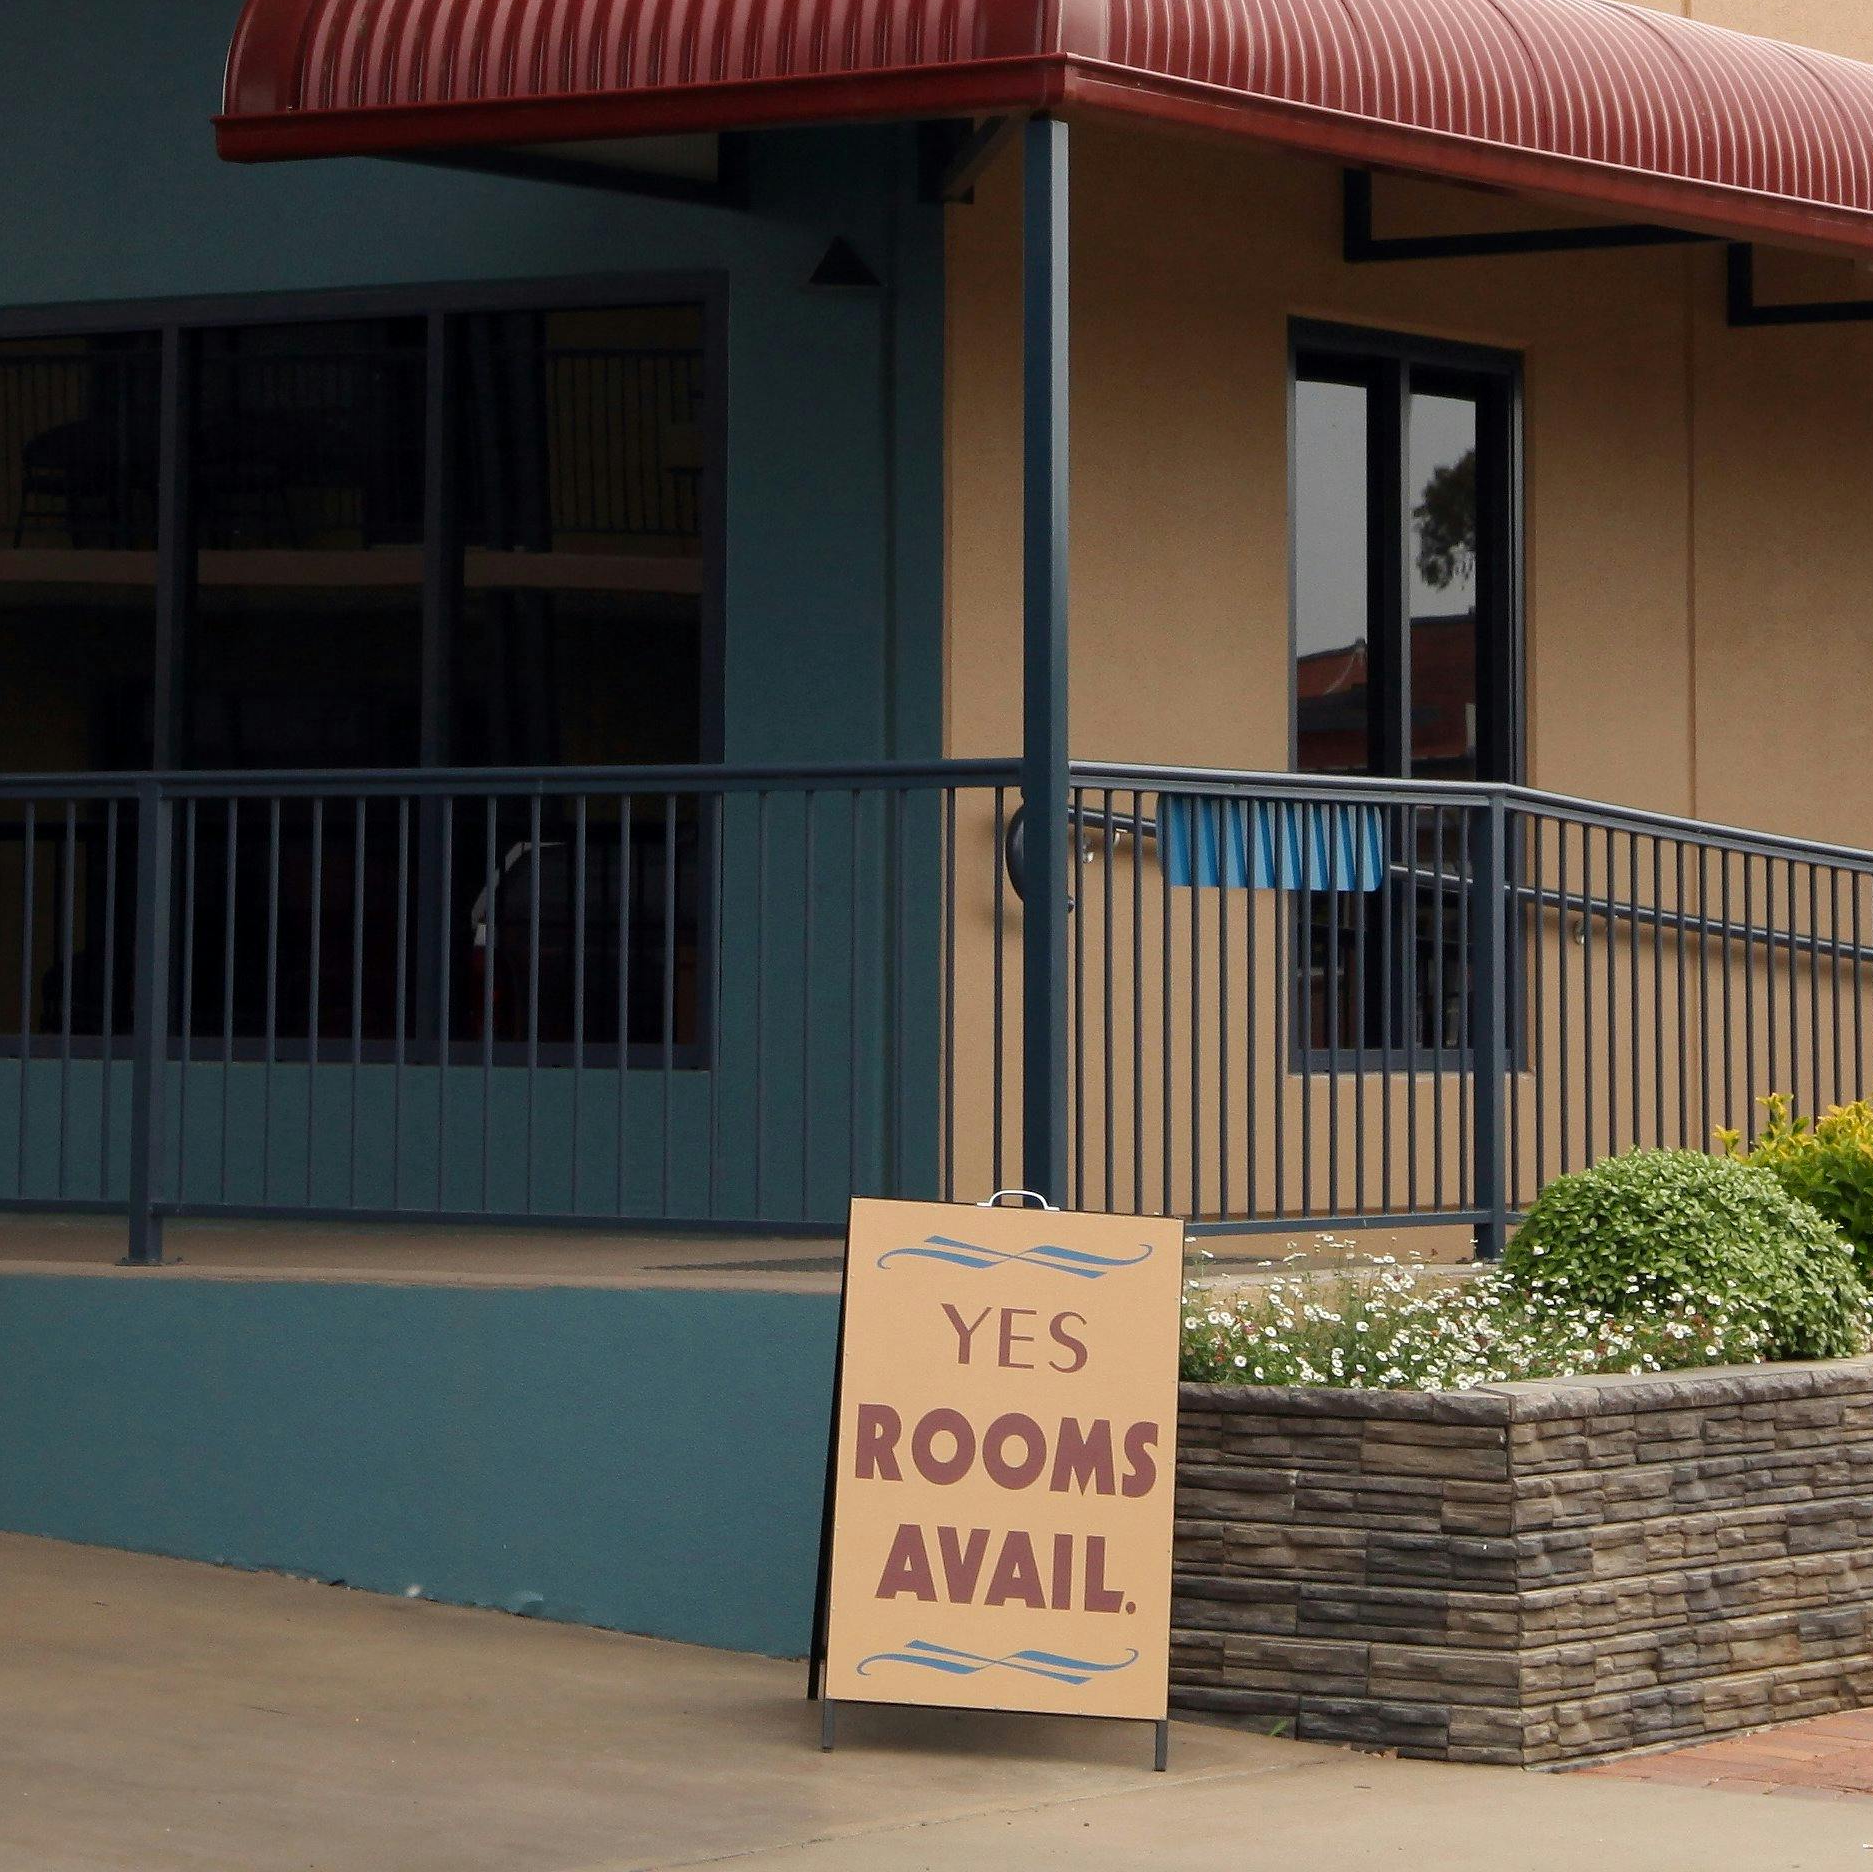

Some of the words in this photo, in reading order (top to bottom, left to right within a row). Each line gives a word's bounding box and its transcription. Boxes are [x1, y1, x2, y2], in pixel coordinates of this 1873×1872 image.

[940, 1302, 1089, 1373] YES
[854, 1403, 1159, 1498] ROOMS
[876, 1523, 1137, 1615] AVAIL.
